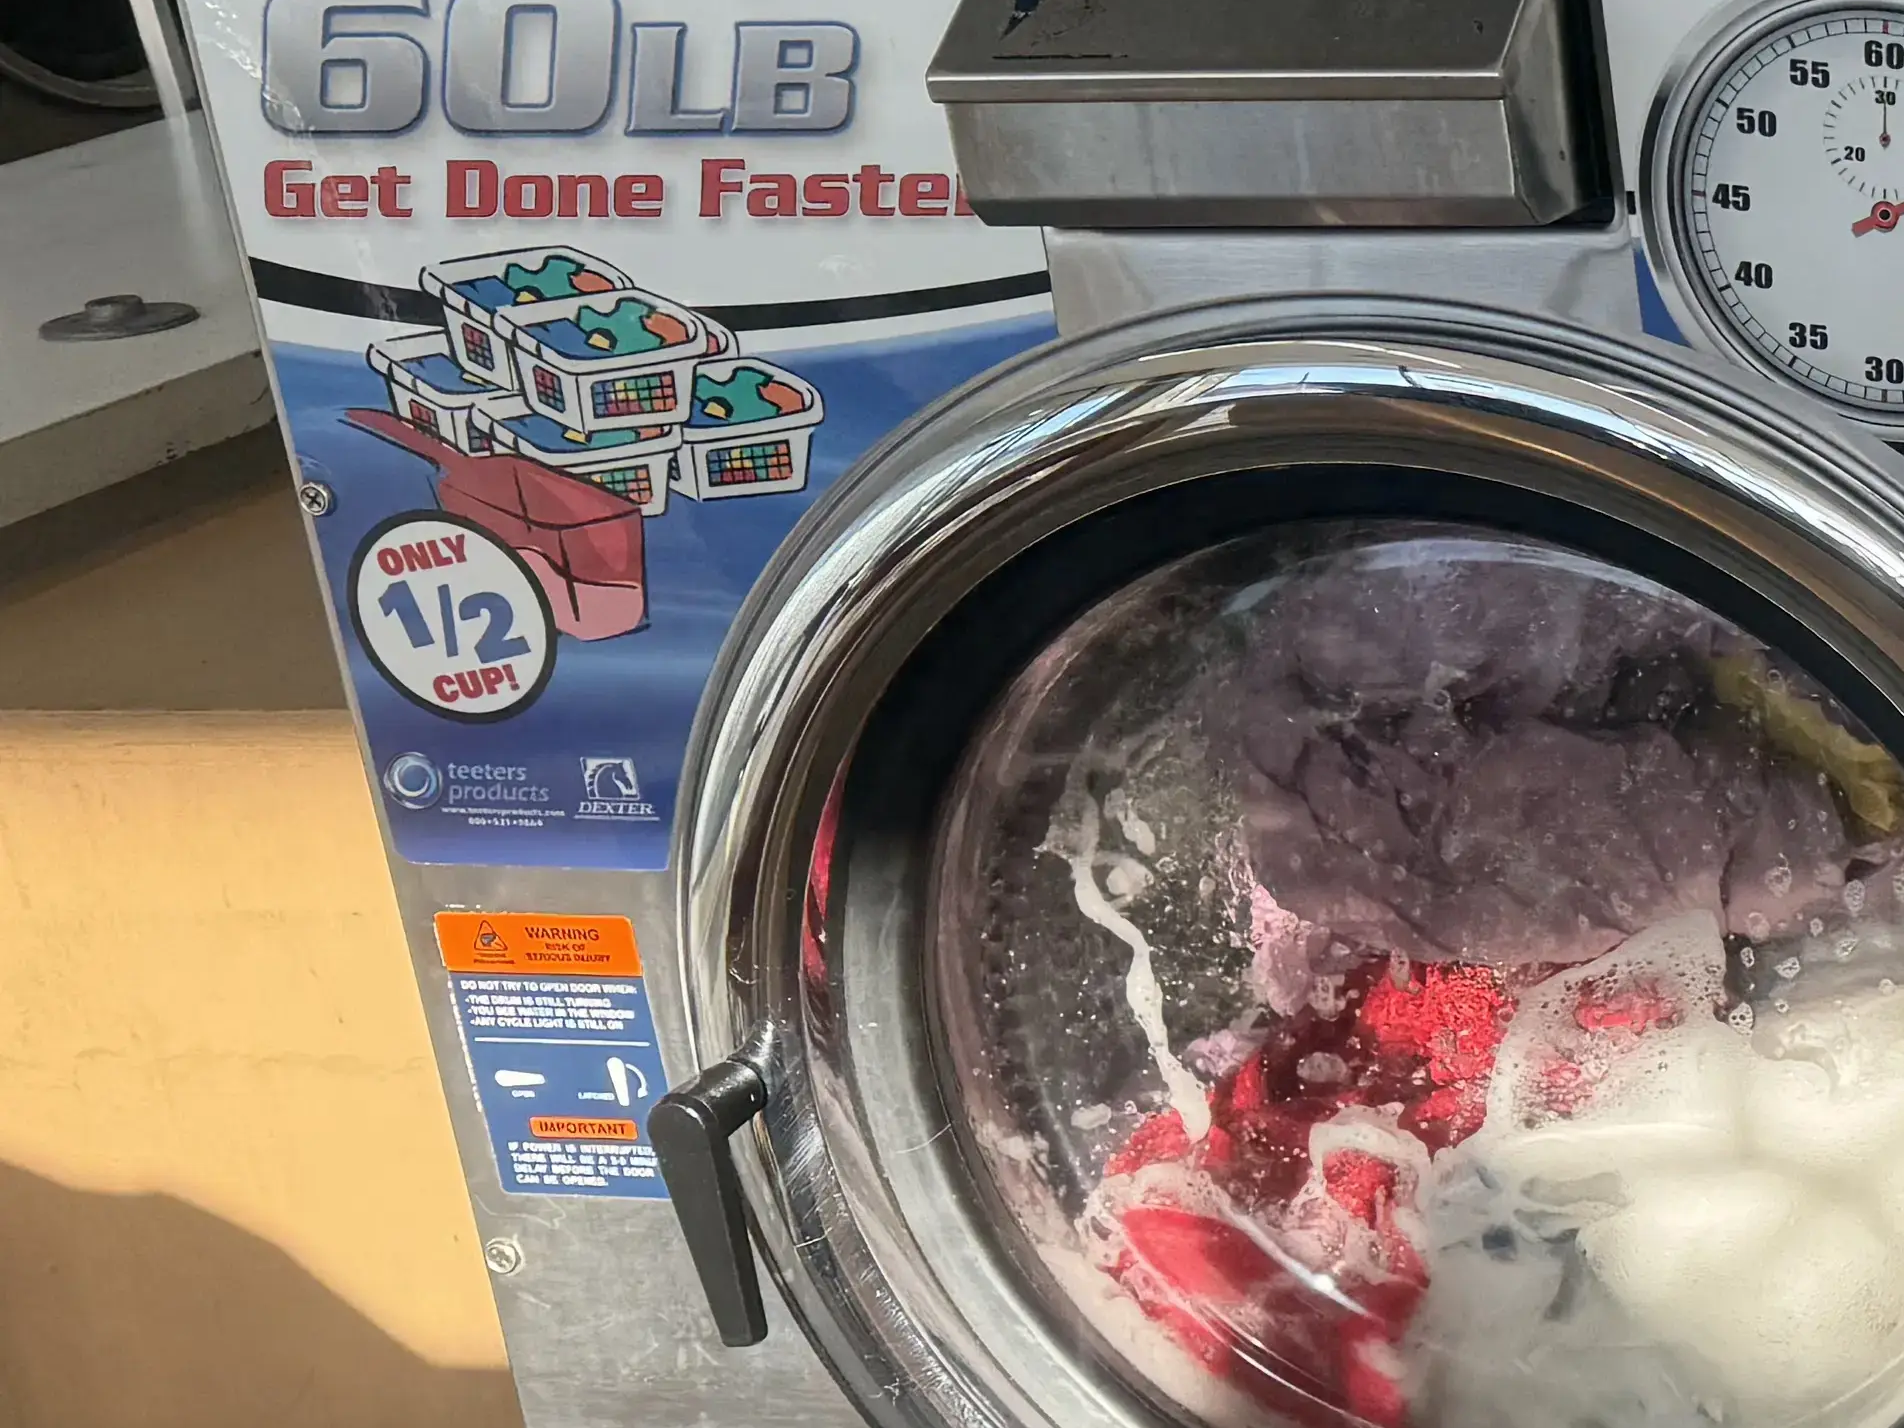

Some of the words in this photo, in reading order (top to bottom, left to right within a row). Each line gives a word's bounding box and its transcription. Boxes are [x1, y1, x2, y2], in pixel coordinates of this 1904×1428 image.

[1865, 40, 1904, 69] 60
[1790, 59, 1829, 88] 55
[1737, 107, 1776, 137] 50
[264, 158, 414, 218] Get
[445, 160, 665, 220] Done
[1712, 184, 1750, 211] 45
[1735, 261, 1772, 288] 40
[1789, 323, 1828, 349] 35
[1865, 357, 1904, 384] 30
[376, 534, 468, 577] ONLY
[378, 580, 532, 664] 1/2
[432, 664, 520, 704] CUP!
